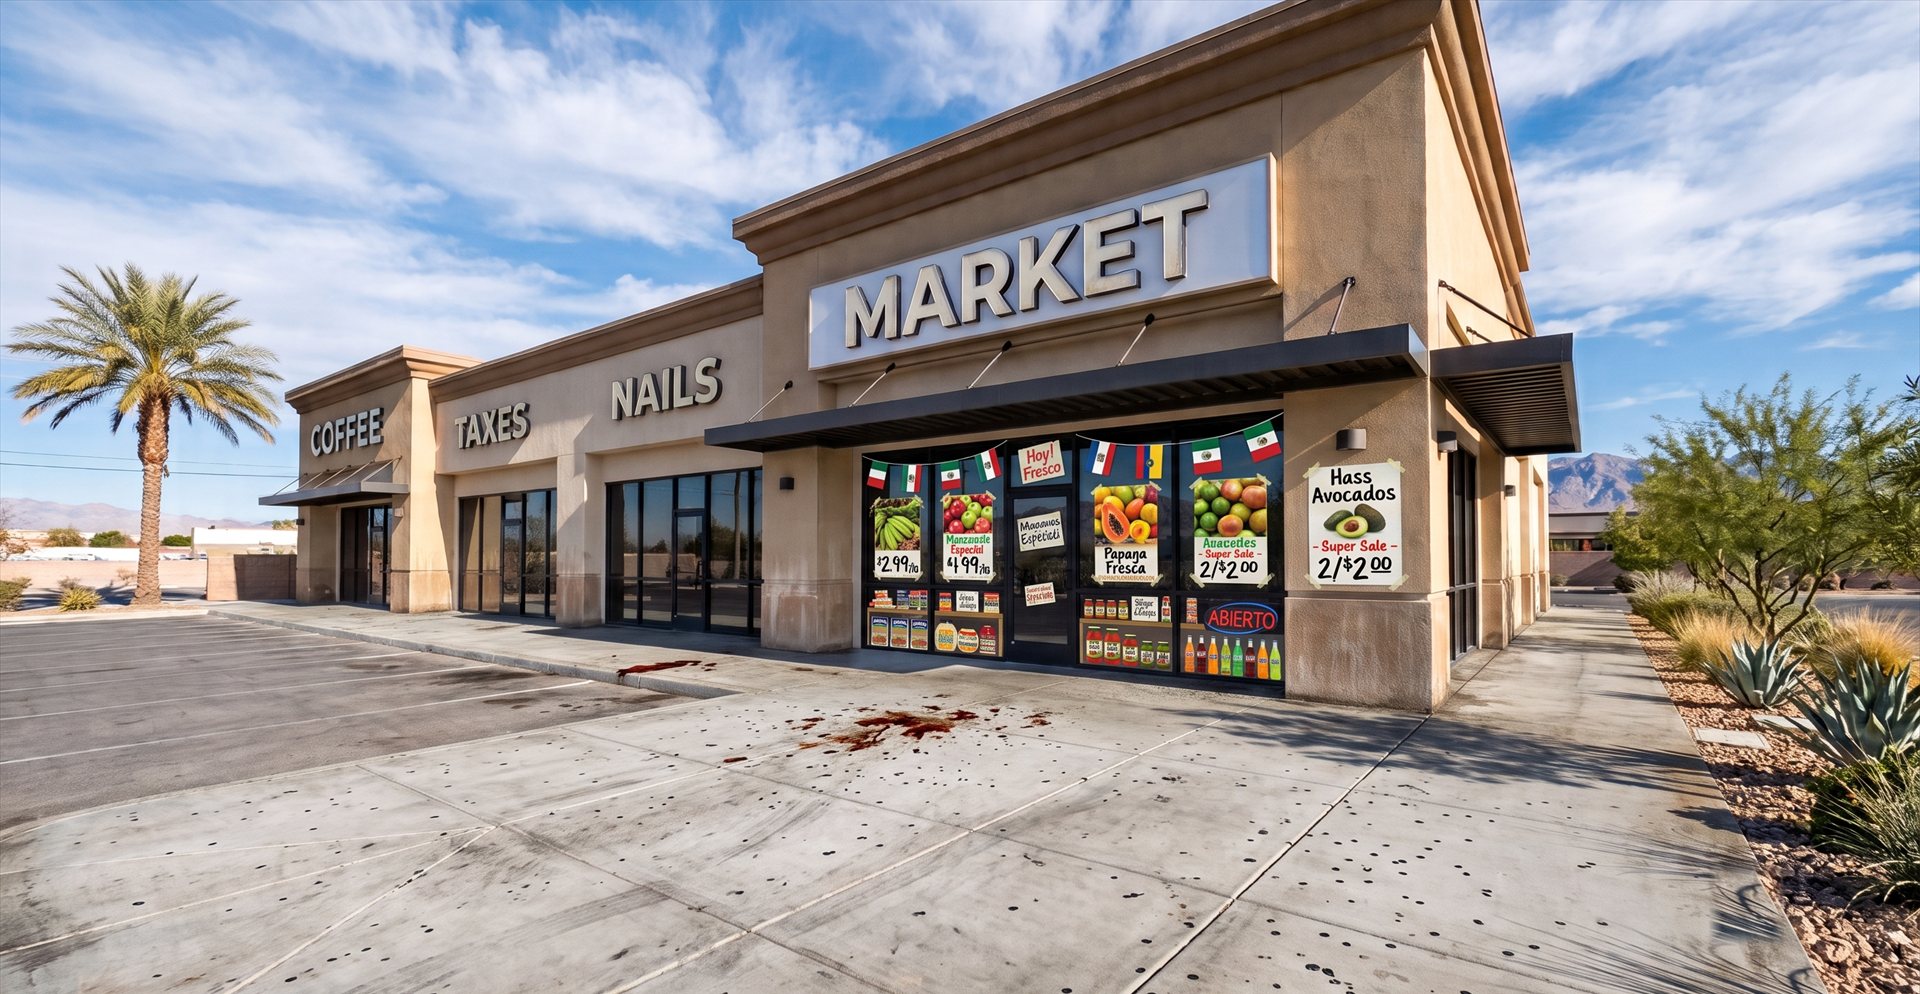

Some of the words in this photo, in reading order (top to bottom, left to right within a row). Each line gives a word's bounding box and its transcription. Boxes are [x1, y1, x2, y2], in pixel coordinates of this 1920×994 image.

[844, 188, 1210, 348] MARKET
[611, 357, 723, 421] NAILS
[310, 407, 385, 457] COFFEE
[454, 402, 531, 450] TAXES
[1026, 443, 1054, 466] Hoy!
[1023, 463, 1061, 481] Fresco
[1330, 467, 1372, 486] Hass
[1311, 484, 1396, 504] Avocados
[1205, 549, 1232, 560] Super
[1233, 549, 1255, 558] Sale
[1321, 539, 1356, 555] Super
[1359, 539, 1388, 552] Sale
[1105, 560, 1146, 574] Fresca
[1208, 609, 1276, 631] ABIERTO
